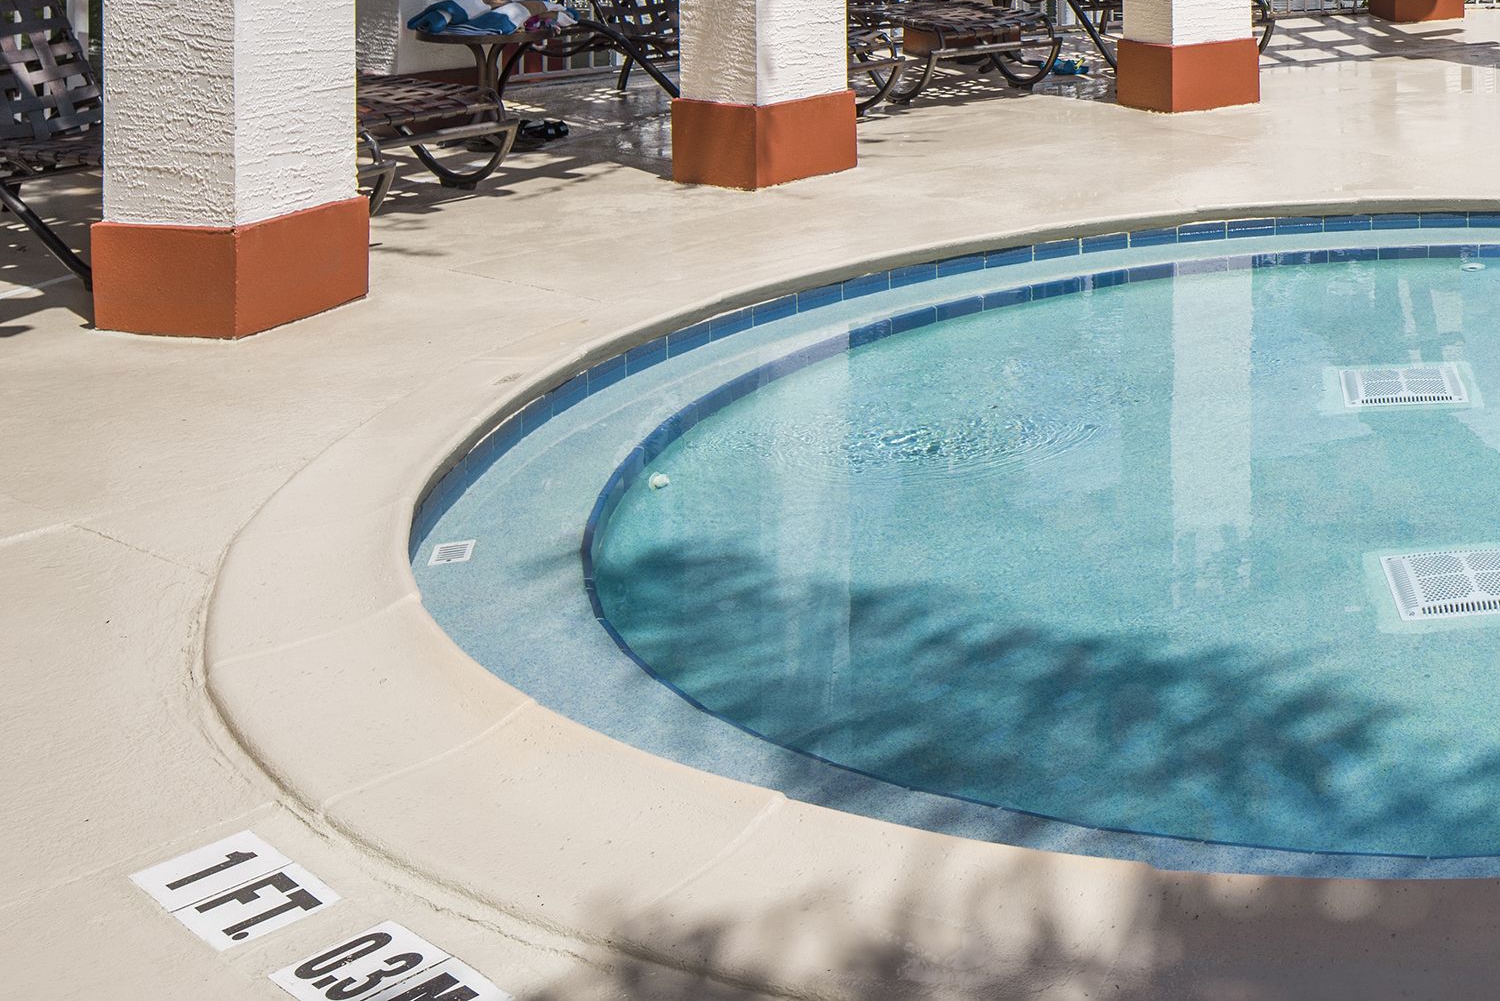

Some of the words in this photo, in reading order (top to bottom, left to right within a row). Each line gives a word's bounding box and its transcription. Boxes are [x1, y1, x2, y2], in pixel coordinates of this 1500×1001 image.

[165, 850, 258, 891] 1
[194, 871, 323, 941] FT.
[294, 932, 424, 1000] 0.3
